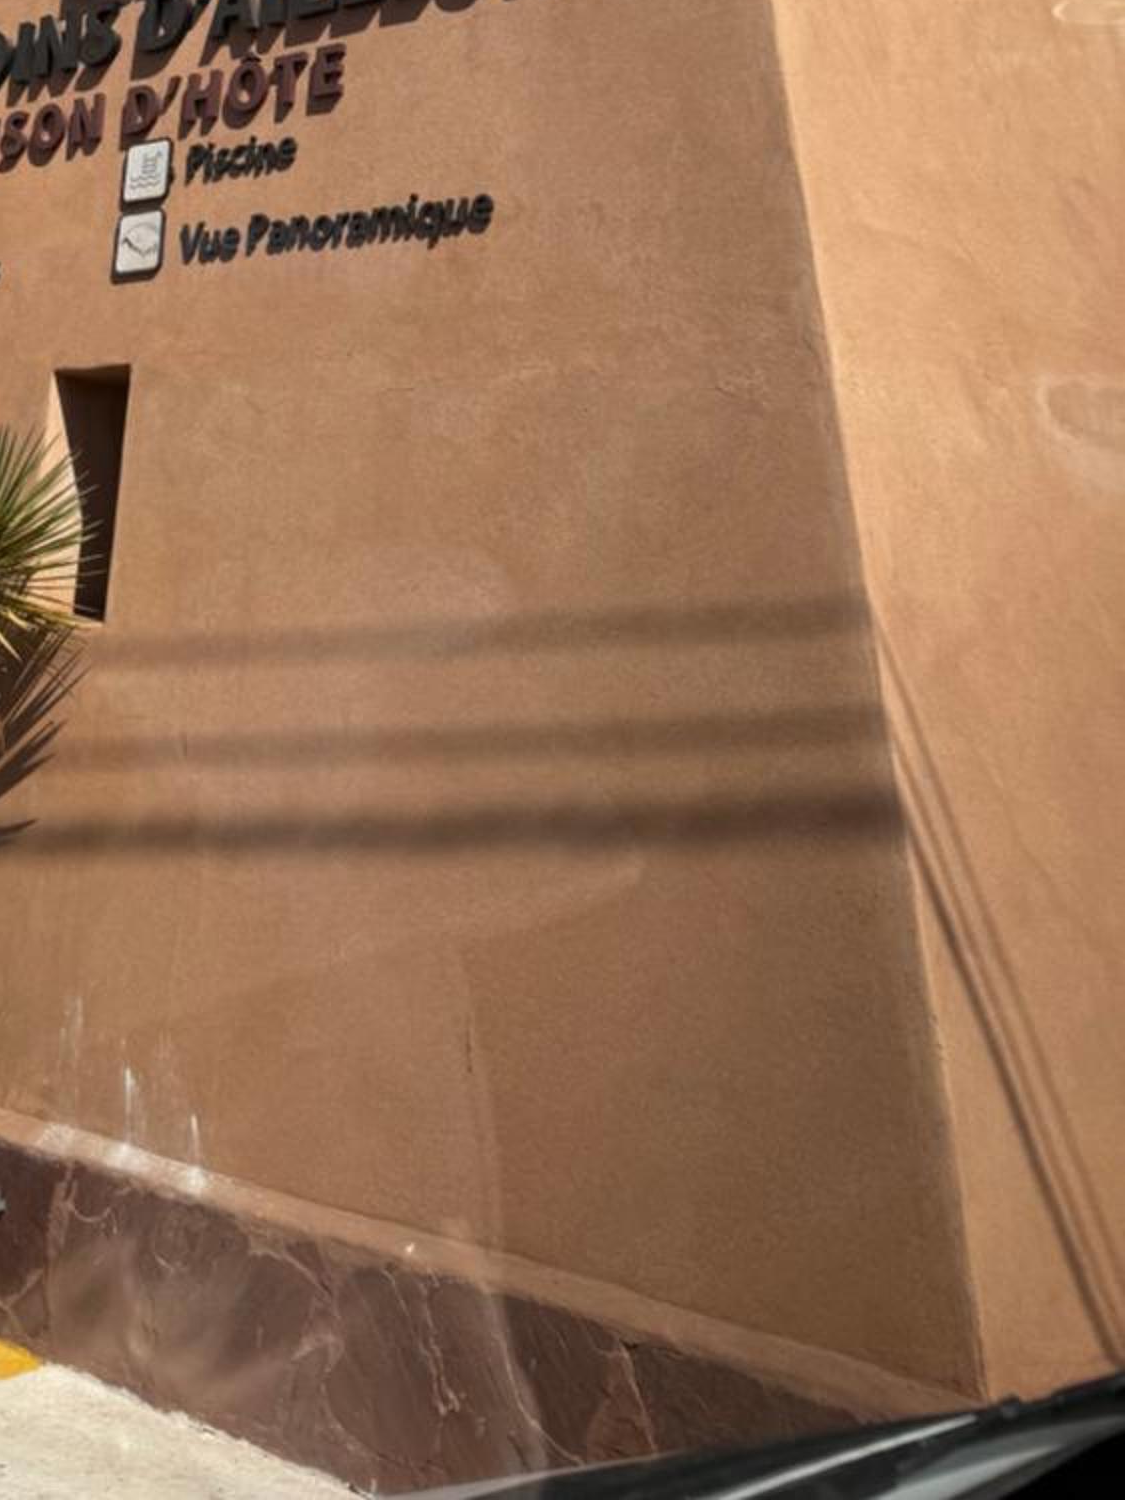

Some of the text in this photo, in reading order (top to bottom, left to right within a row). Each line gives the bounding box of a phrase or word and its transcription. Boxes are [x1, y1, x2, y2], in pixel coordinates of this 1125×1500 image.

[121, 44, 346, 143] D'HÔTE
[185, 137, 297, 184] Piscine
[180, 194, 493, 264] Vue Panoramique
